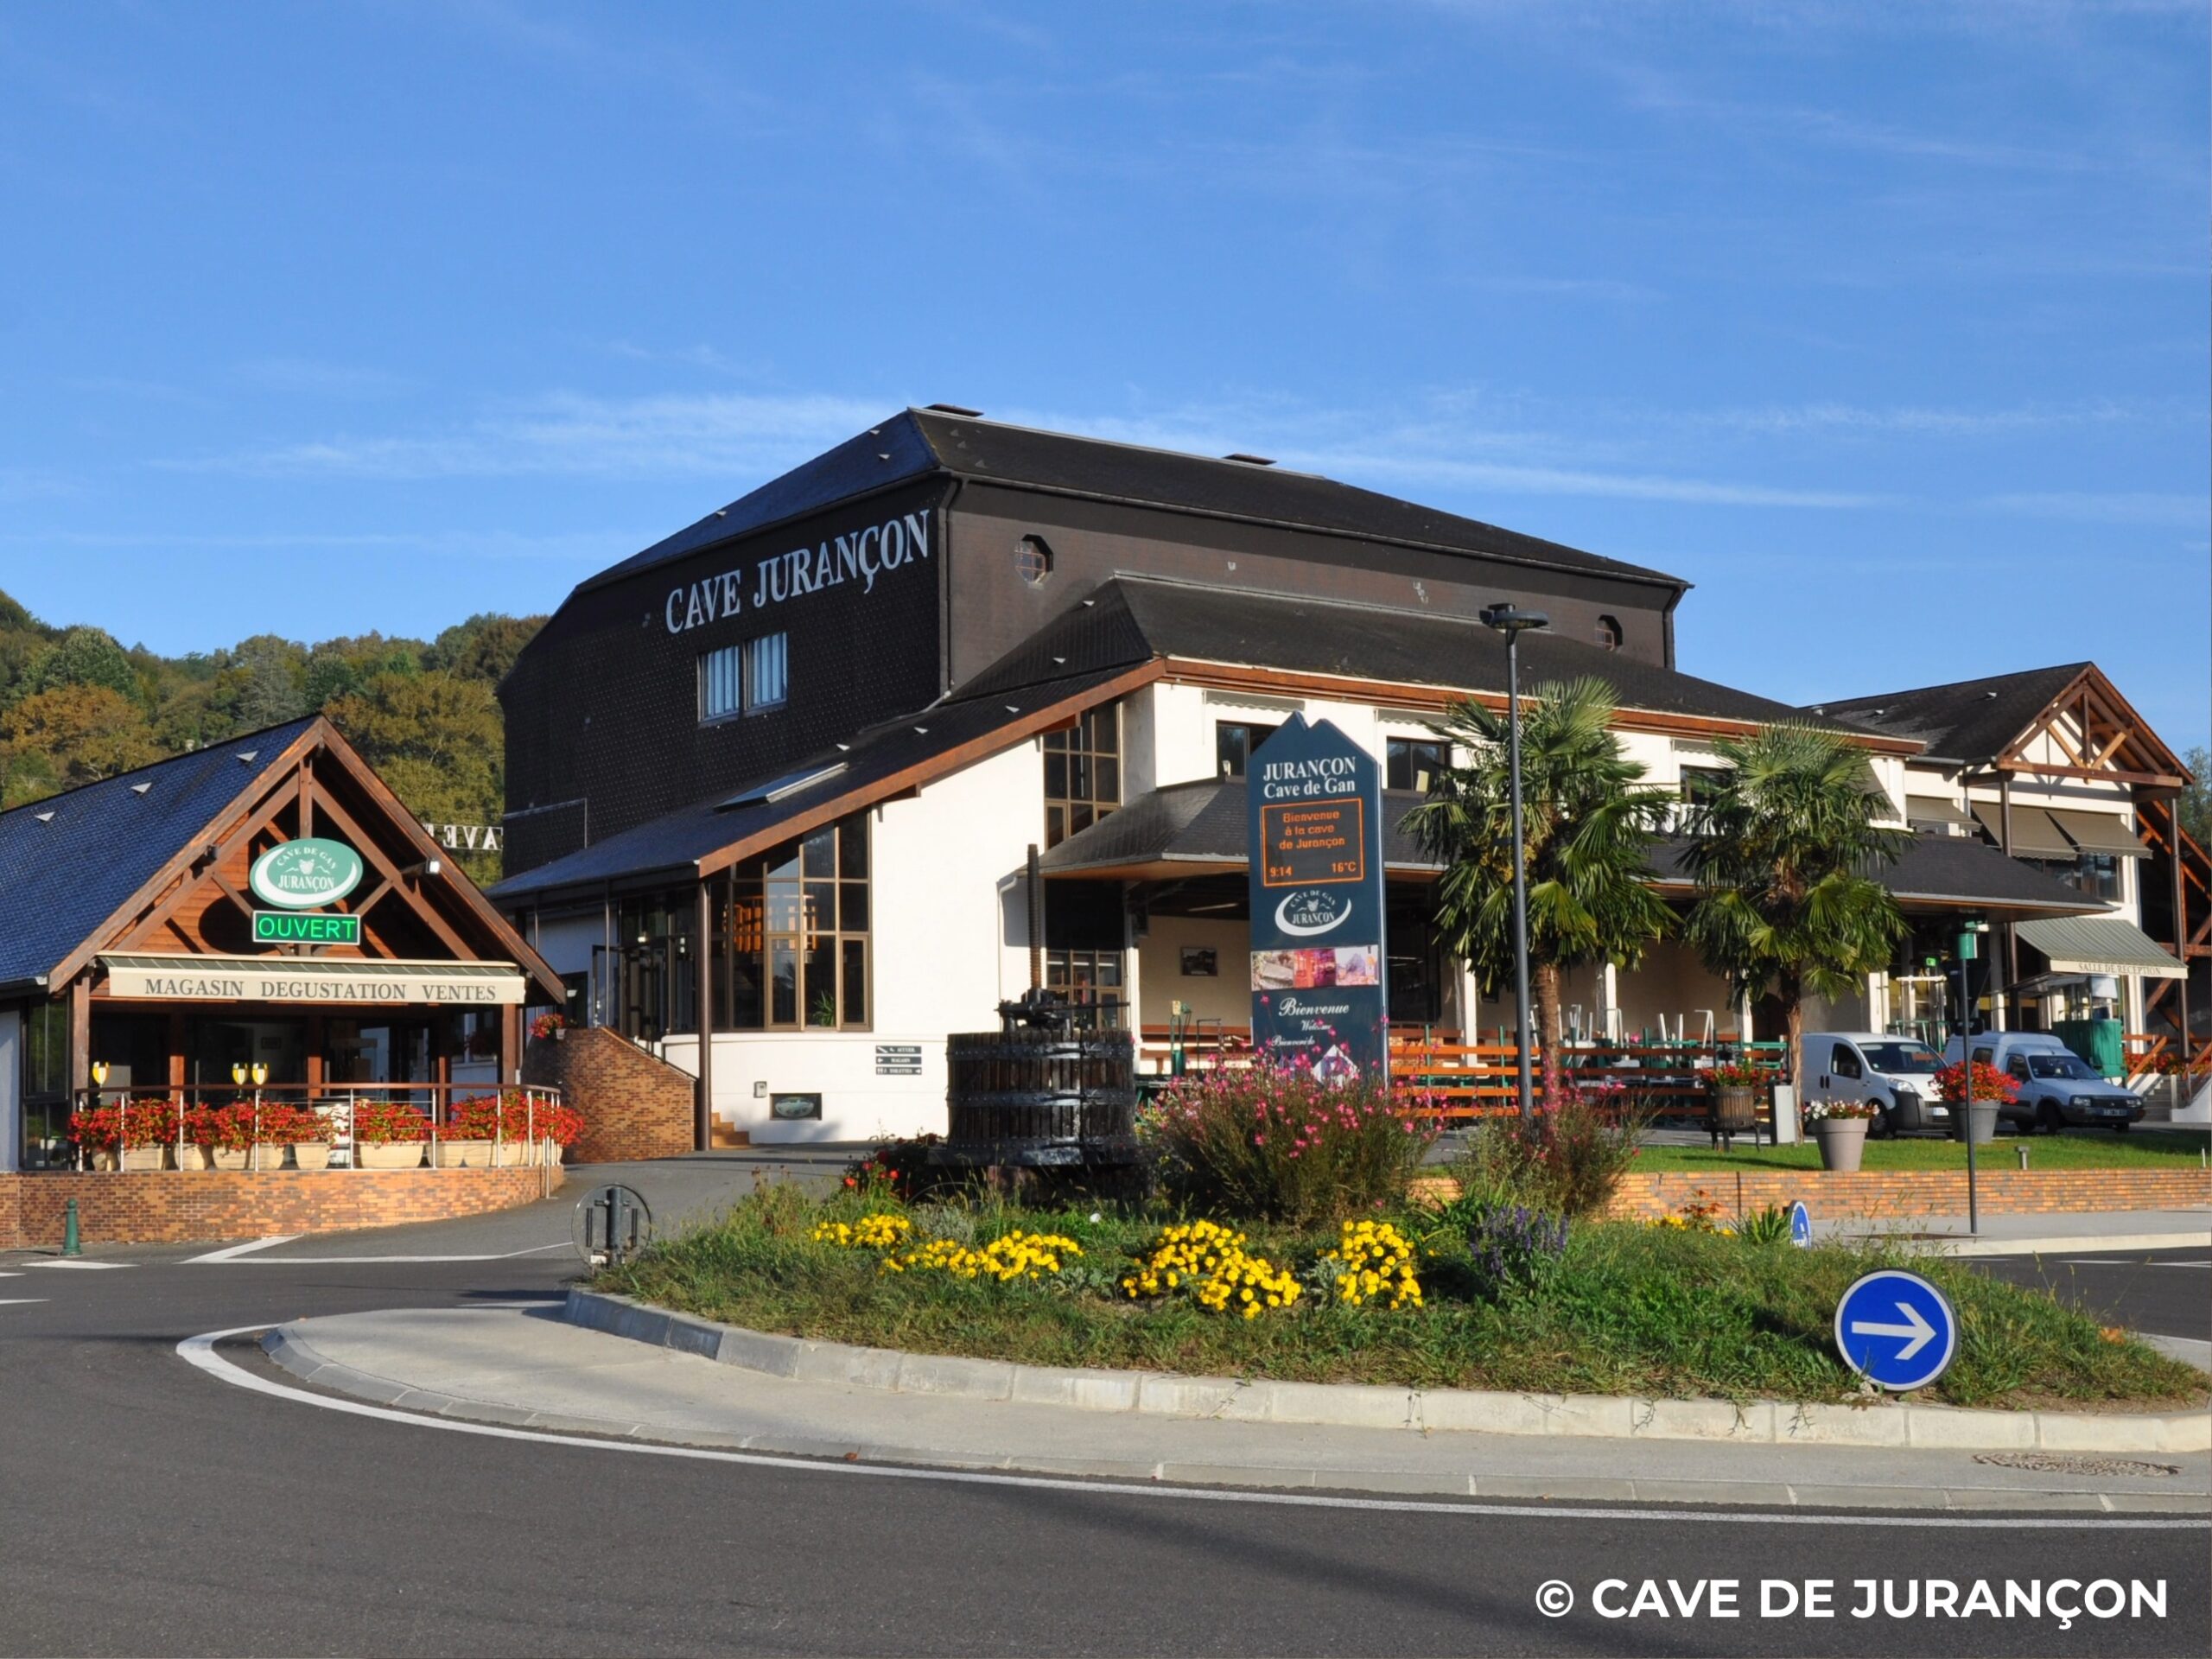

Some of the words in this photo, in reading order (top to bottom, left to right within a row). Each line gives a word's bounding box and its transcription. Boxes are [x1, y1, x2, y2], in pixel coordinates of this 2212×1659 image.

[665, 569, 741, 634] CAVE
[753, 509, 930, 608] JURANÇON
[1263, 756, 1356, 780] JURANÇON
[1263, 783, 1300, 798] Cave
[1303, 780, 1320, 796] de
[1325, 778, 1356, 793] Gan
[1282, 810, 1339, 823] Bienvenue
[1285, 827, 1292, 836] à
[1294, 826, 1305, 835] la
[1308, 824, 1334, 834] cave
[1279, 840, 1293, 849] de
[1296, 837, 1344, 849] Jurançon
[276, 847, 302, 867] CAVE
[303, 847, 317, 855] DE
[278, 874, 335, 892] JURANÇON
[1290, 891, 1310, 907] CAVE
[1292, 911, 1335, 925] JURANÇON
[258, 917, 355, 939] OUVERT
[2078, 963, 2102, 972] SALLE
[2105, 963, 2115, 973] DE
[145, 978, 244, 997] MAGASIN
[261, 980, 406, 1001] DEGUSTATION
[422, 983, 496, 1002] VENTES
[1278, 996, 1350, 1017] Bienvenue
